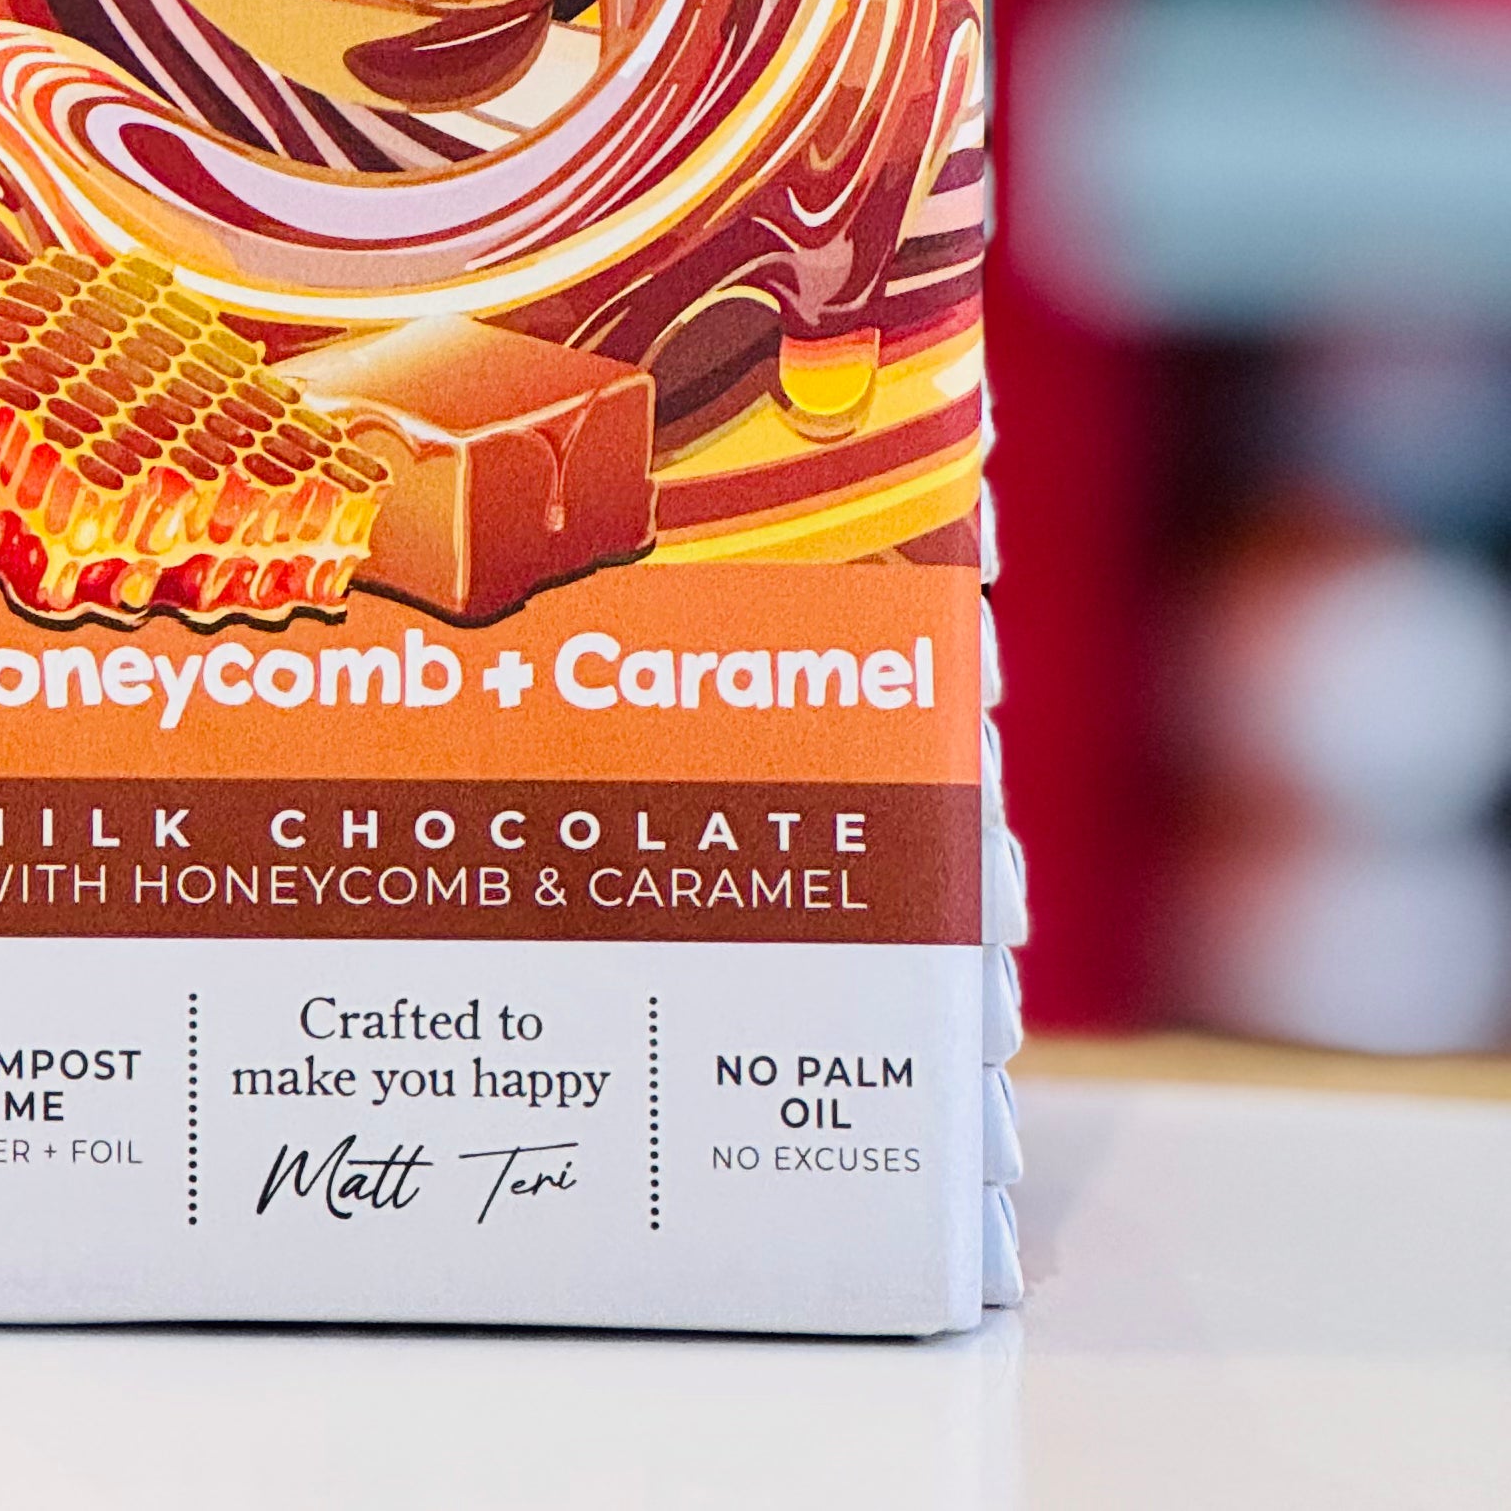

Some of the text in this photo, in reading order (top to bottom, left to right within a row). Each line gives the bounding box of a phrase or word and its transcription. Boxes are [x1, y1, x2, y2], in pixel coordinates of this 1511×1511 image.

[482, 650, 534, 706] +
[553, 632, 935, 710] Caramel
[270, 809, 867, 852] CHOCOLATE
[134, 864, 511, 906] HONEYCOMB
[534, 867, 568, 907] &
[588, 867, 868, 910] CARAMEL
[300, 996, 543, 1041] Crafted to
[232, 1054, 611, 1108] make you happy
[716, 1055, 913, 1088] NO PALM
[4, 1090, 64, 1122] ME
[780, 1097, 852, 1130] OIL
[43, 1143, 58, 1159] +
[71, 1139, 143, 1165] FOIL
[712, 1145, 921, 1173] NO EXCUSES
[256, 1134, 434, 1220] Matt
